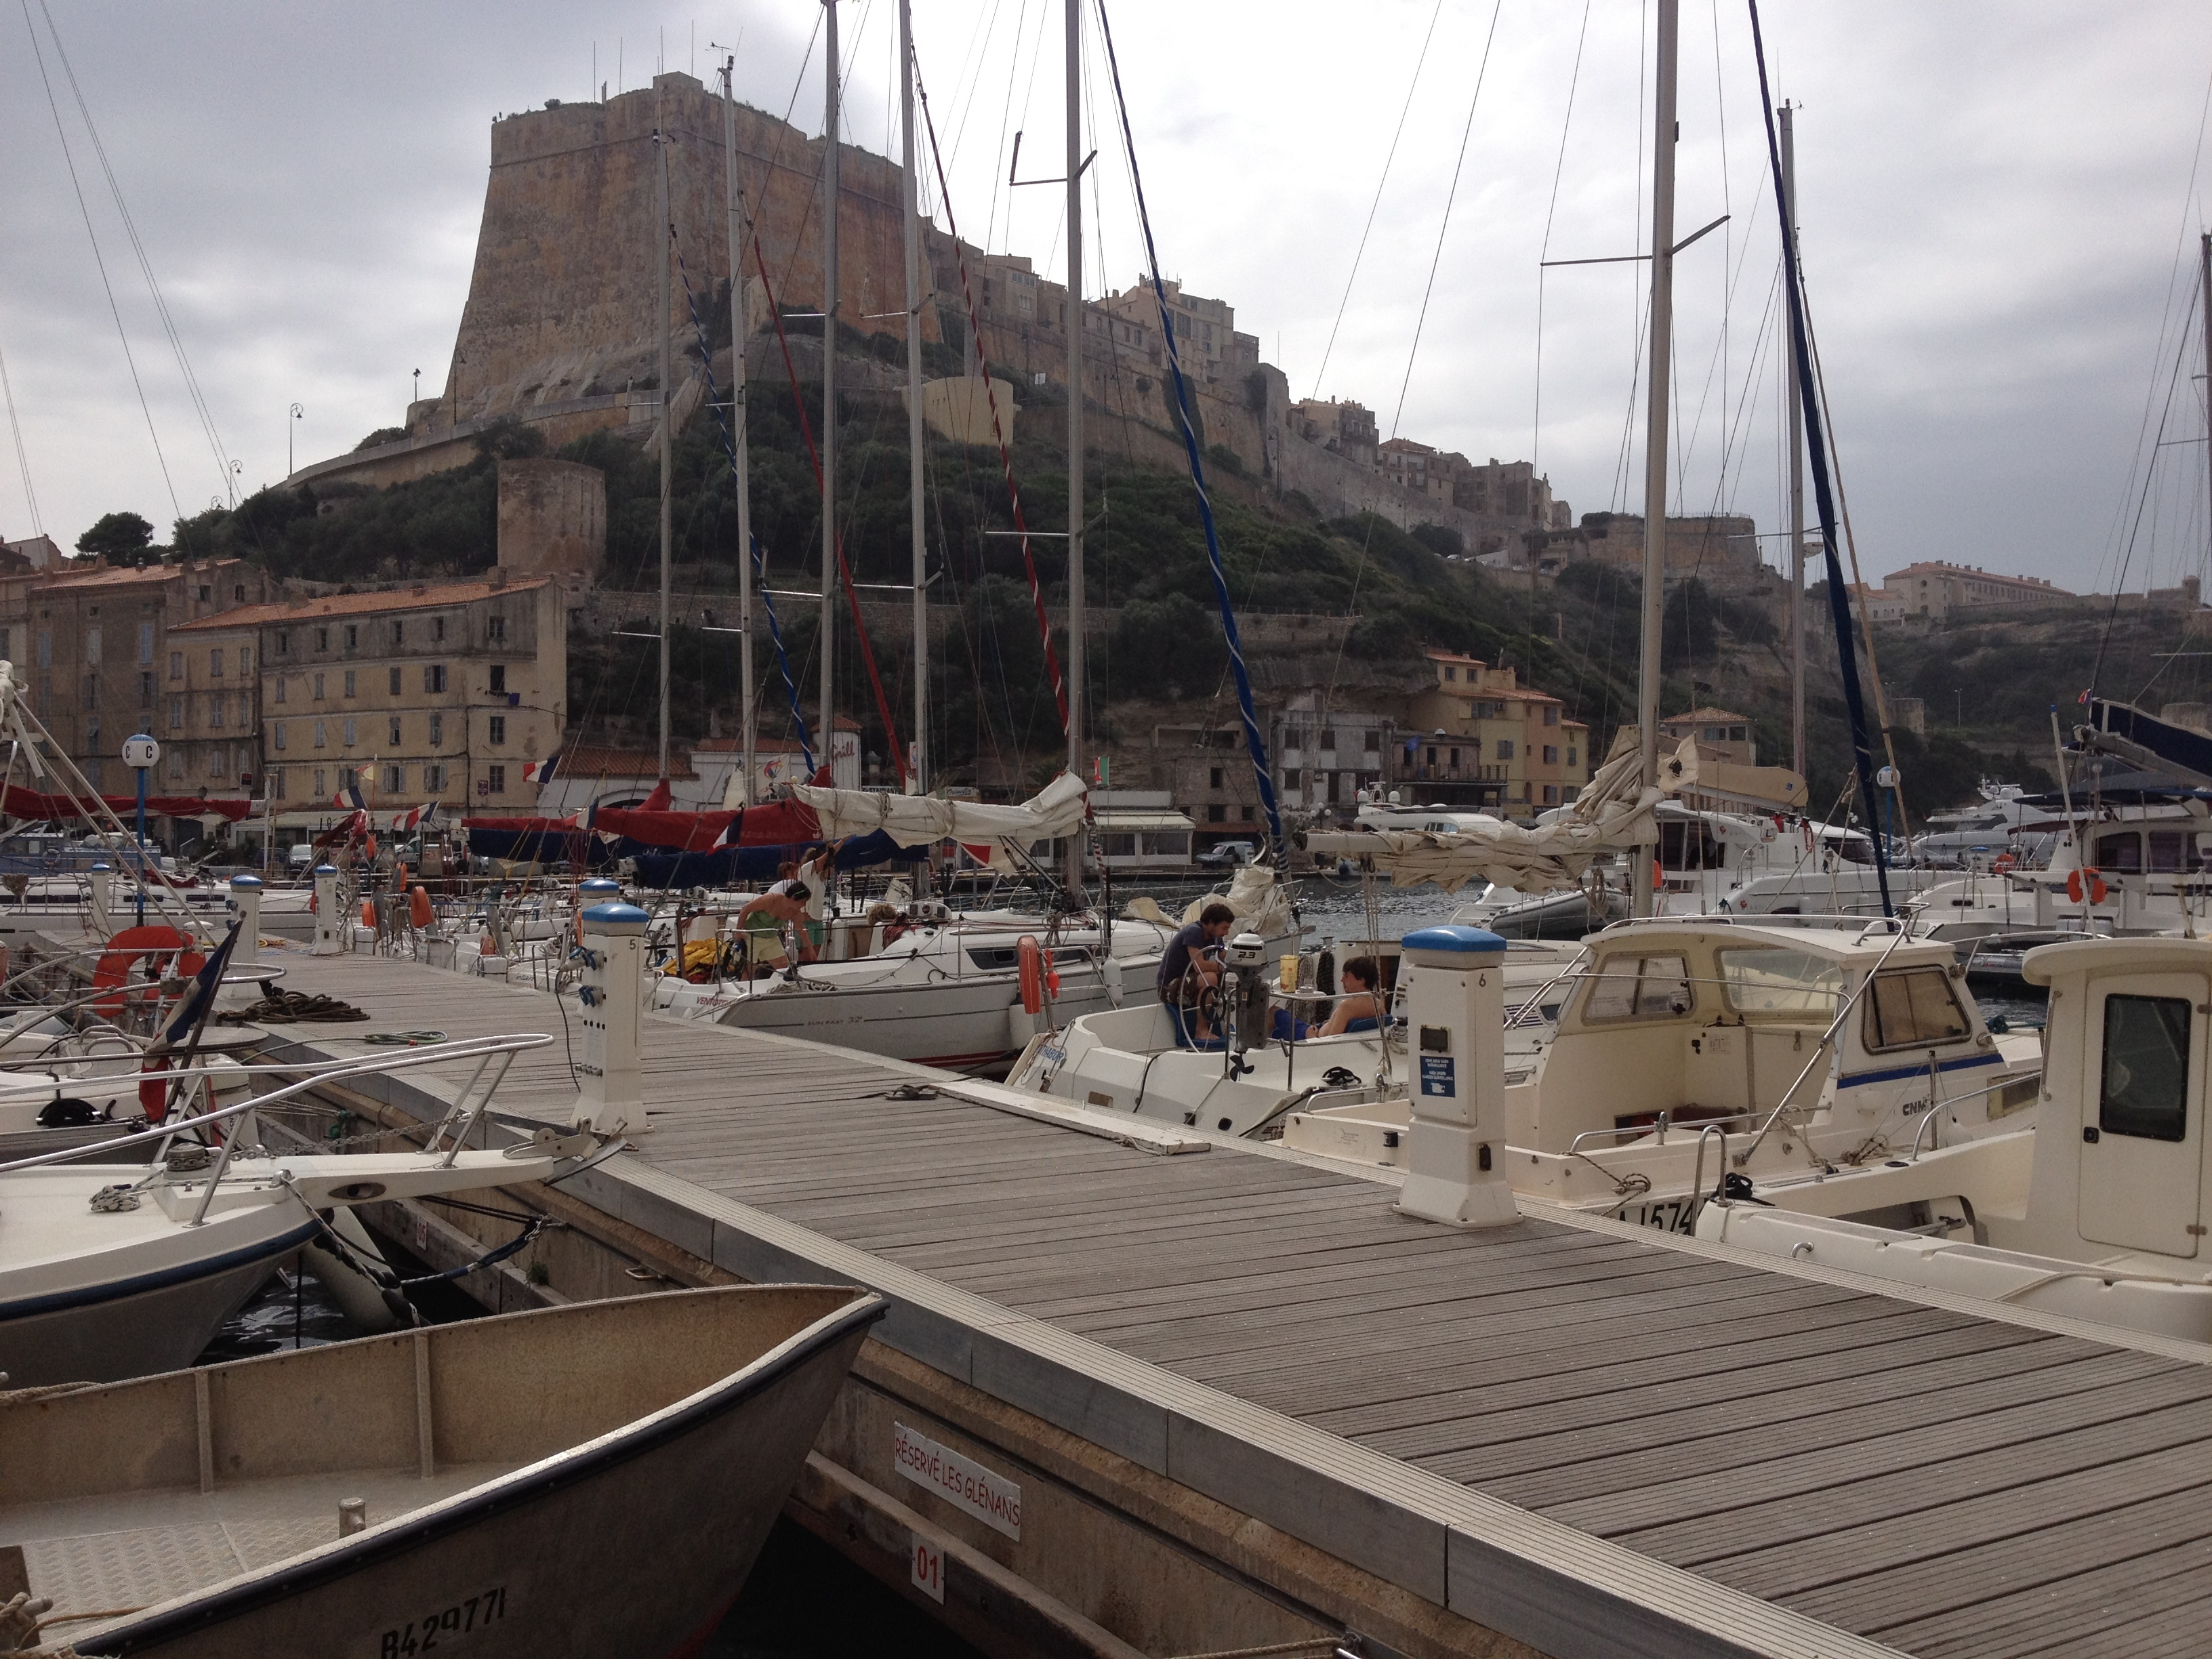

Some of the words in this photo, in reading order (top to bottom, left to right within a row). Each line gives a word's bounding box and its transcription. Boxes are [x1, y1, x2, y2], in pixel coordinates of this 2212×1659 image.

[146, 745, 152, 759] C
[629, 939, 636, 950] 5
[1237, 951, 1256, 959] 2.3
[1479, 972, 1486, 987] 6
[895, 1433, 940, 1482] RÉSERVÉ
[943, 1463, 962, 1494] LES
[965, 1475, 1020, 1527] GLÉNANS
[917, 1546, 937, 1589] 01
